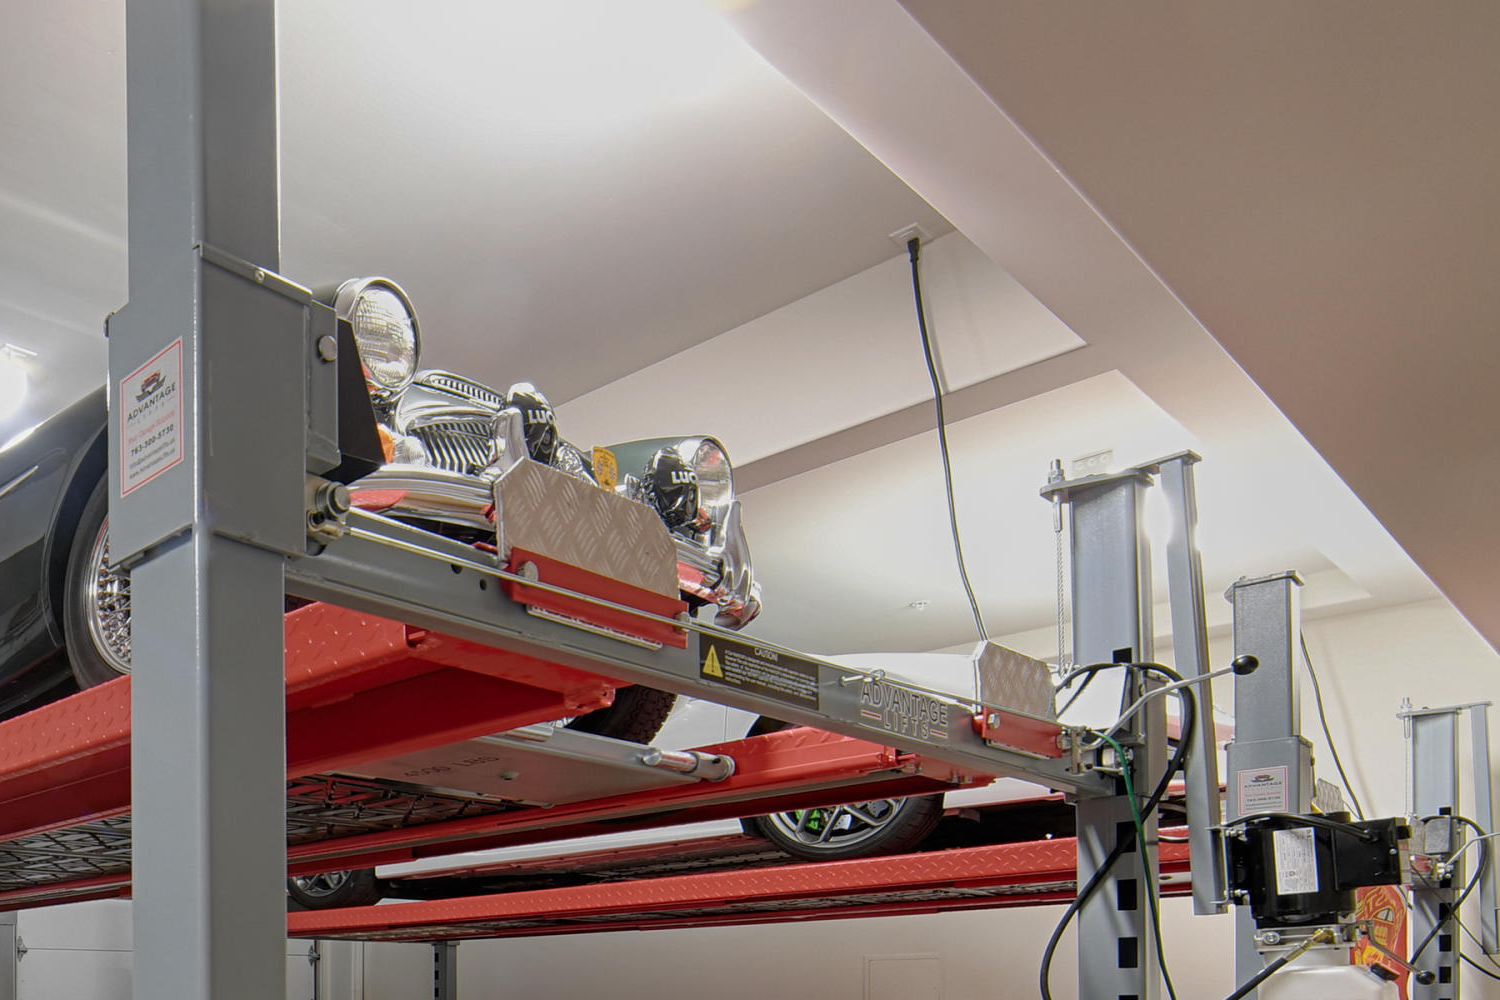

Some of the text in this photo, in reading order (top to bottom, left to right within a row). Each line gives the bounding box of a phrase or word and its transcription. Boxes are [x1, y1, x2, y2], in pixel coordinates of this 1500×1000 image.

[127, 382, 176, 422] ADVANTAGE
[861, 681, 948, 728] ADVANTAGE
[883, 709, 929, 739] LIFTS
